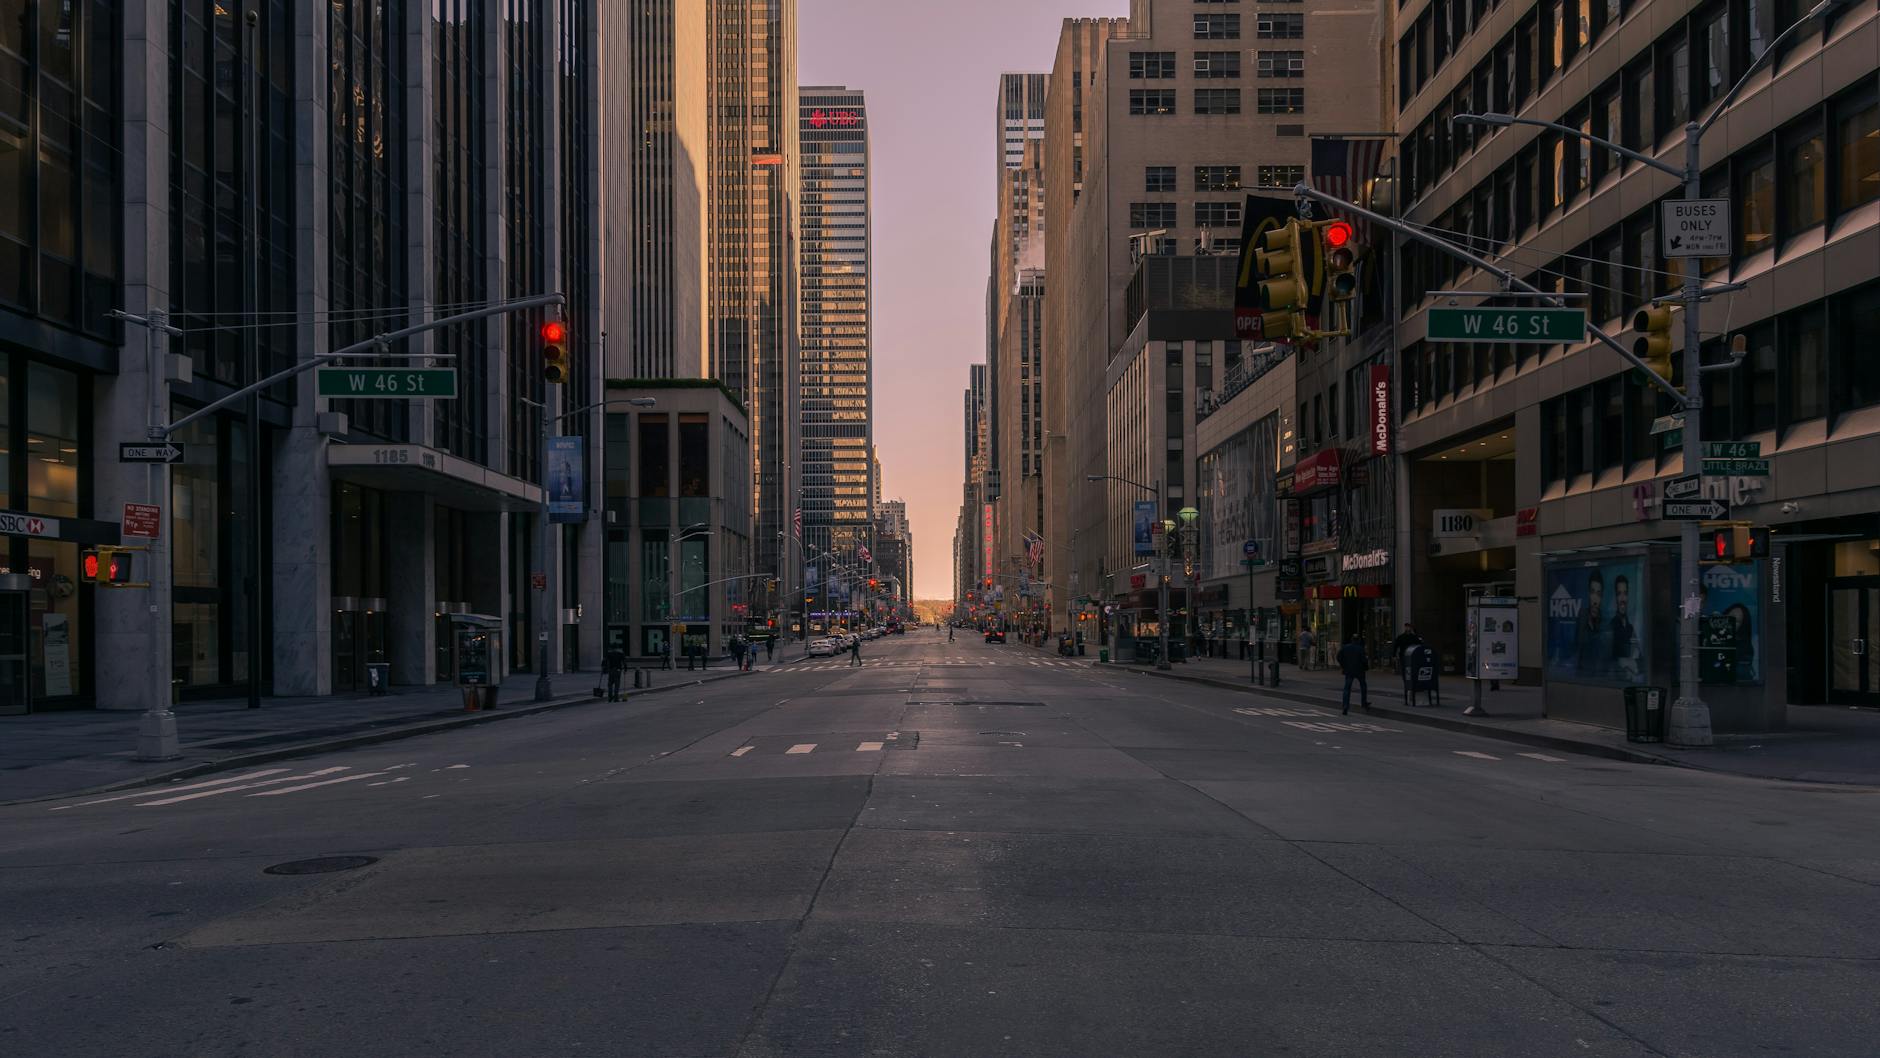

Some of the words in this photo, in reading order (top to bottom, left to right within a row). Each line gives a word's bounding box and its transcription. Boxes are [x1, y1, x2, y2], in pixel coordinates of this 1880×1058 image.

[829, 111, 858, 125] UBS
[1676, 205, 1717, 217] BUSES
[1680, 219, 1712, 231] ONLY
[1715, 242, 1727, 250] FRI
[1237, 316, 1262, 331] OPE
[1463, 314, 1483, 334] W
[1492, 314, 1519, 335] 46
[1529, 315, 1550, 336] St
[348, 374, 366, 392] W
[375, 374, 398, 392] 46
[406, 374, 425, 392] St
[1375, 381, 1388, 453] McDonald's
[128, 448, 147, 457] ONE
[156, 448, 175, 457] WAY
[373, 449, 409, 464] 1185
[1712, 444, 1723, 457] W
[1728, 444, 1747, 457] 46
[1703, 461, 1731, 471] LITTLE
[1735, 460, 1769, 471] BRAZIL
[1669, 484, 1681, 494] ONE
[1684, 480, 1697, 490] WAY
[1671, 506, 1692, 515] ONE
[1700, 506, 1721, 514] WAY
[1441, 515, 1473, 532] 1180
[1342, 549, 1387, 571] McDonald's
[1703, 573, 1753, 589] HGTV
[1772, 557, 1781, 603] Newsstand
[1549, 598, 1582, 618] HGTV
